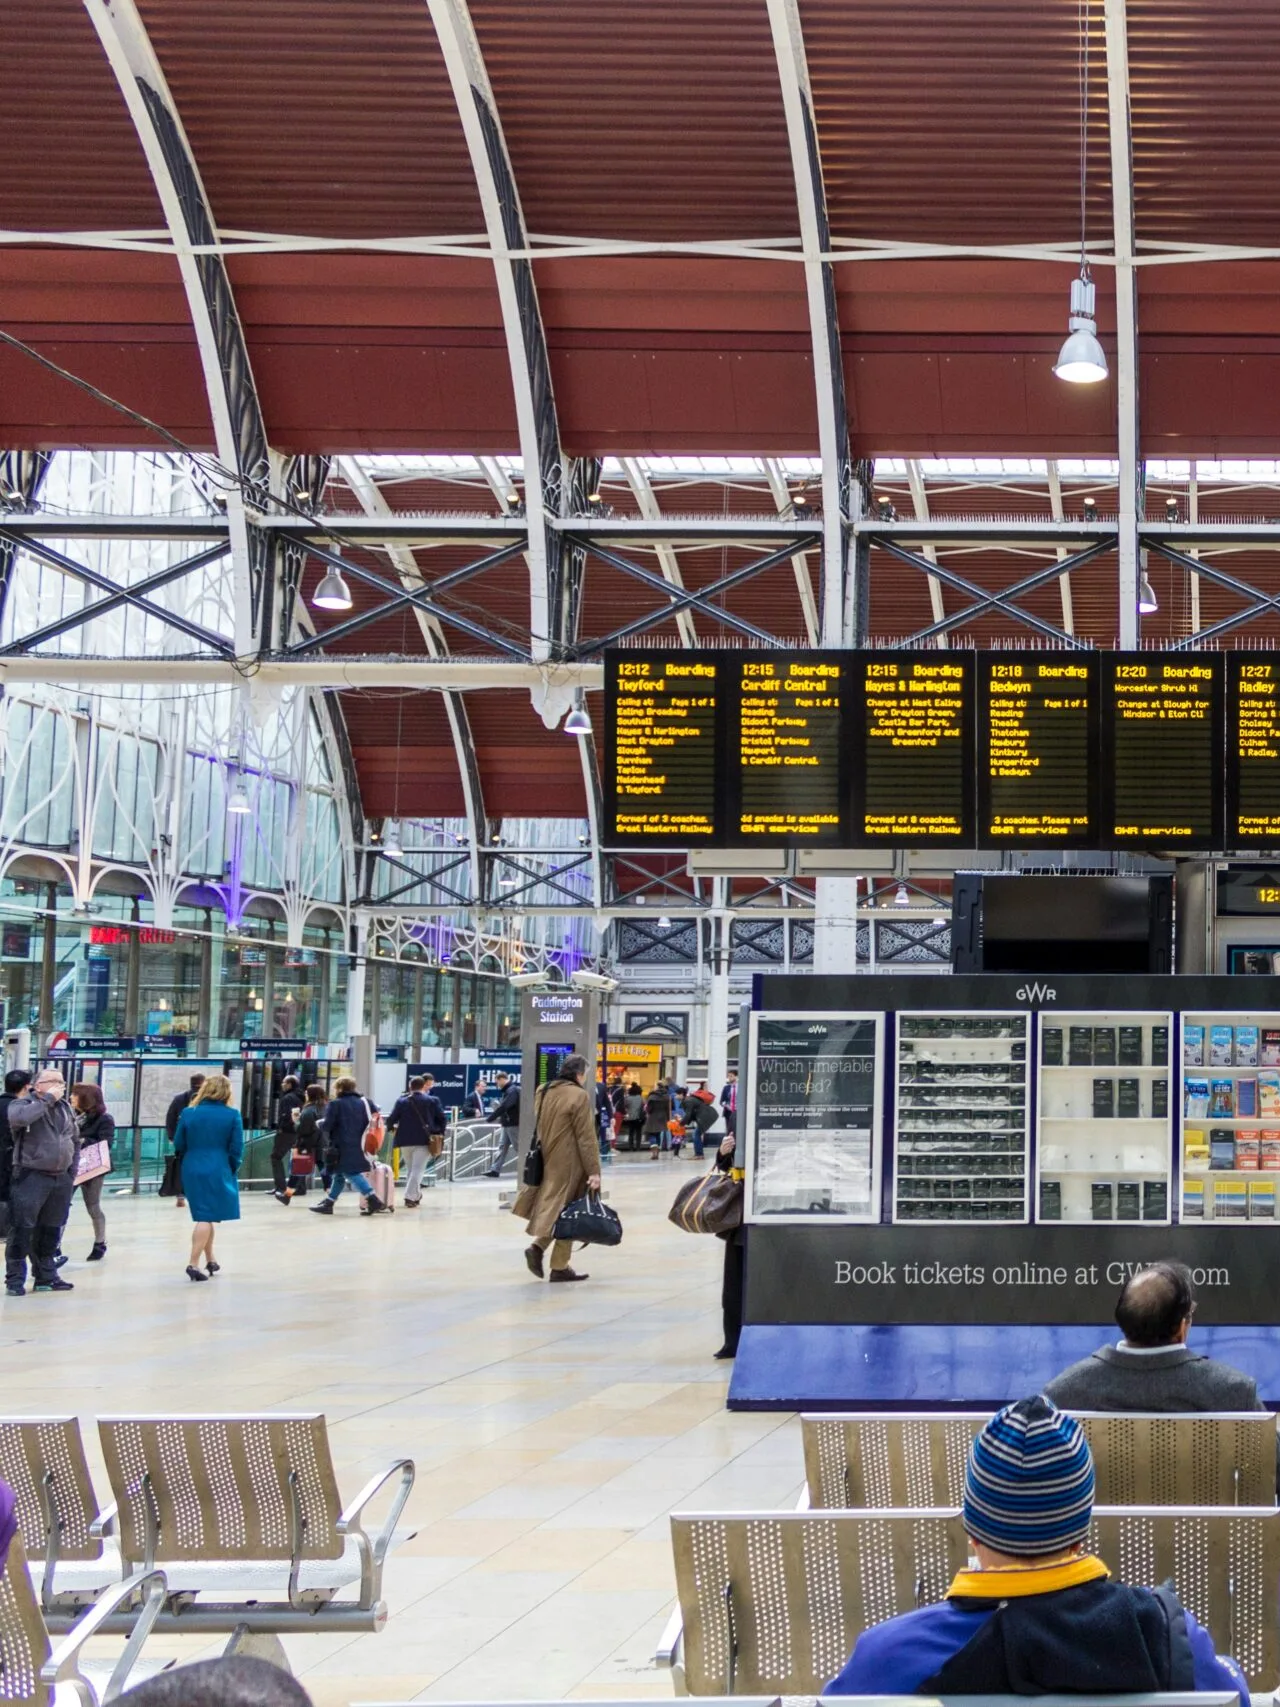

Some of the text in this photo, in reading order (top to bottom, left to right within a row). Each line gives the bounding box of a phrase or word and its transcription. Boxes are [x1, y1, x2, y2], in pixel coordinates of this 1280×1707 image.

[618, 663, 716, 678] 12:12 Boarding
[743, 663, 840, 678] 12:15 Boarding
[867, 664, 963, 678] 12:15 Boarding
[991, 665, 1088, 679] 12:18 Boarding
[1116, 665, 1212, 680] 12:20 Boarding
[1241, 665, 1272, 678] 12:27
[616, 678, 665, 693] Twyford
[741, 679, 827, 692] Cardiff Central
[865, 679, 961, 694] Hayes & Harlington
[989, 680, 1032, 694] Bedwyn
[1239, 681, 1276, 694] Radley
[1016, 981, 1057, 1004] GWR
[531, 996, 583, 1010] Paddington
[540, 1010, 574, 1022] Station
[760, 1058, 873, 1073] Which timetable
[442, 1080, 464, 1088] Station
[759, 1078, 832, 1094] do I need?
[834, 1260, 896, 1285] Book
[903, 1261, 986, 1285] tickets
[992, 1260, 1068, 1285] online
[1075, 1262, 1099, 1285] at
